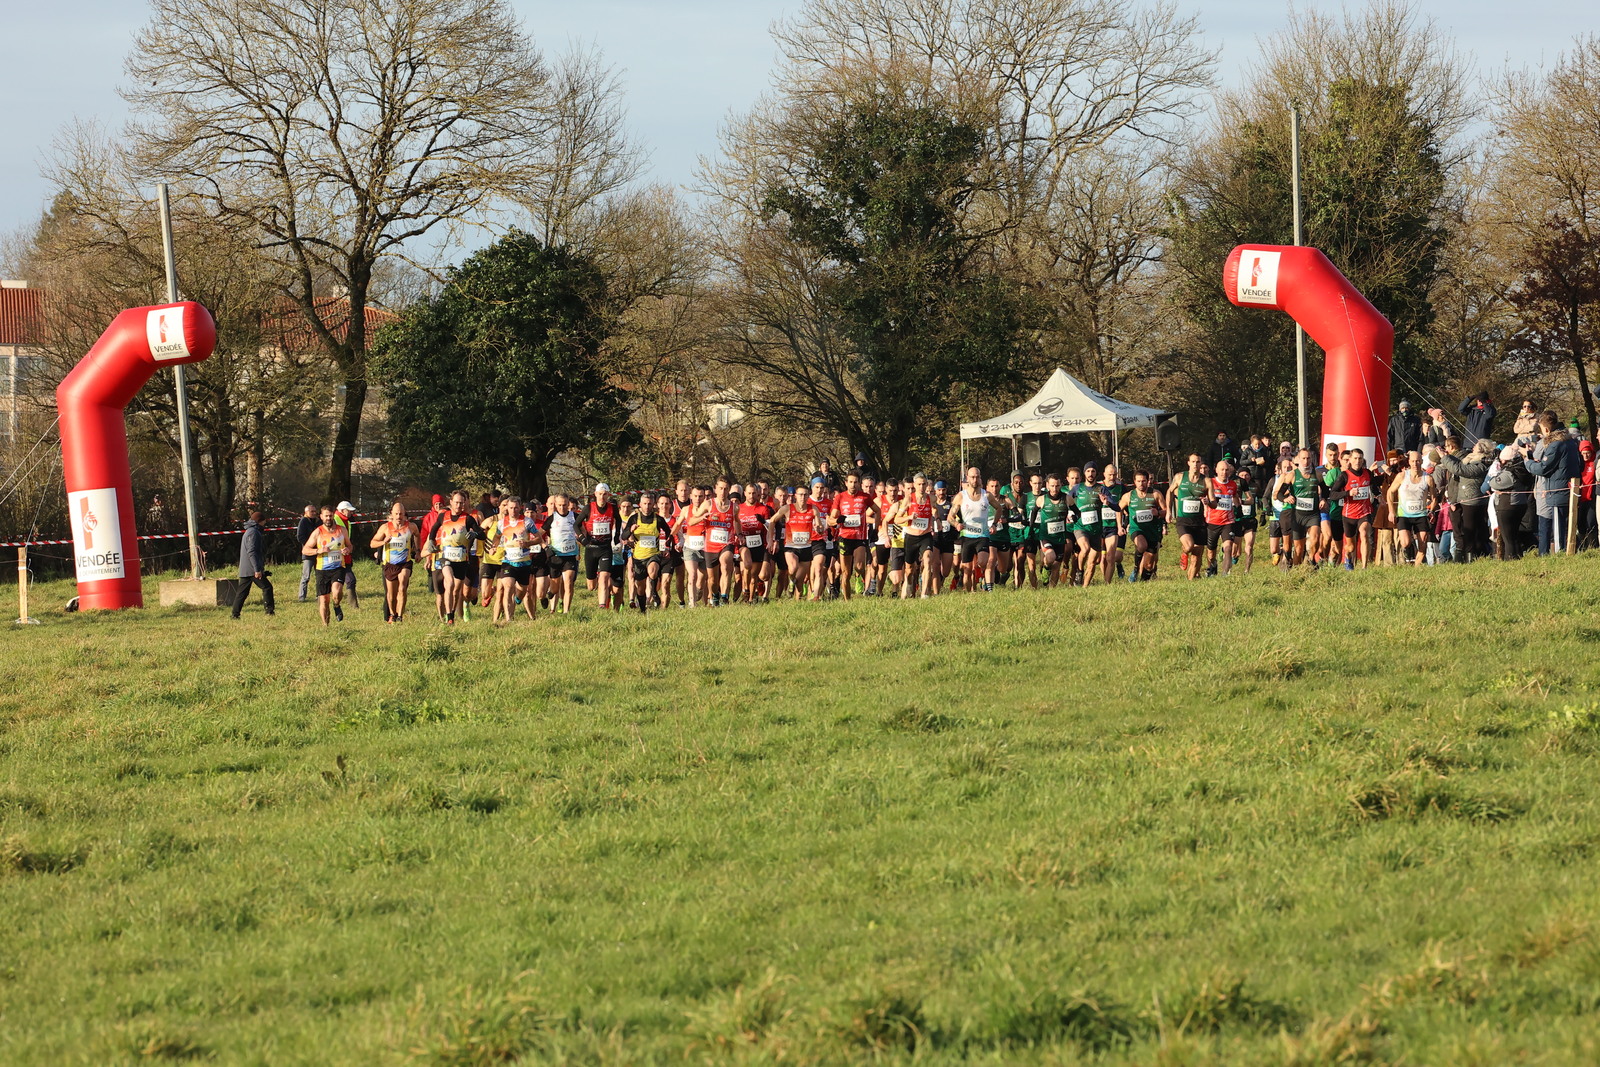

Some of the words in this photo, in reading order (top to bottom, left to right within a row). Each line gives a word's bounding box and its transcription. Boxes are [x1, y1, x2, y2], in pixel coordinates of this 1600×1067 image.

[1242, 288, 1272, 297] VENDÉE
[154, 343, 183, 352] VENDÉE
[990, 422, 1024, 432] 24MX
[77, 550, 120, 568] VENDÉE
